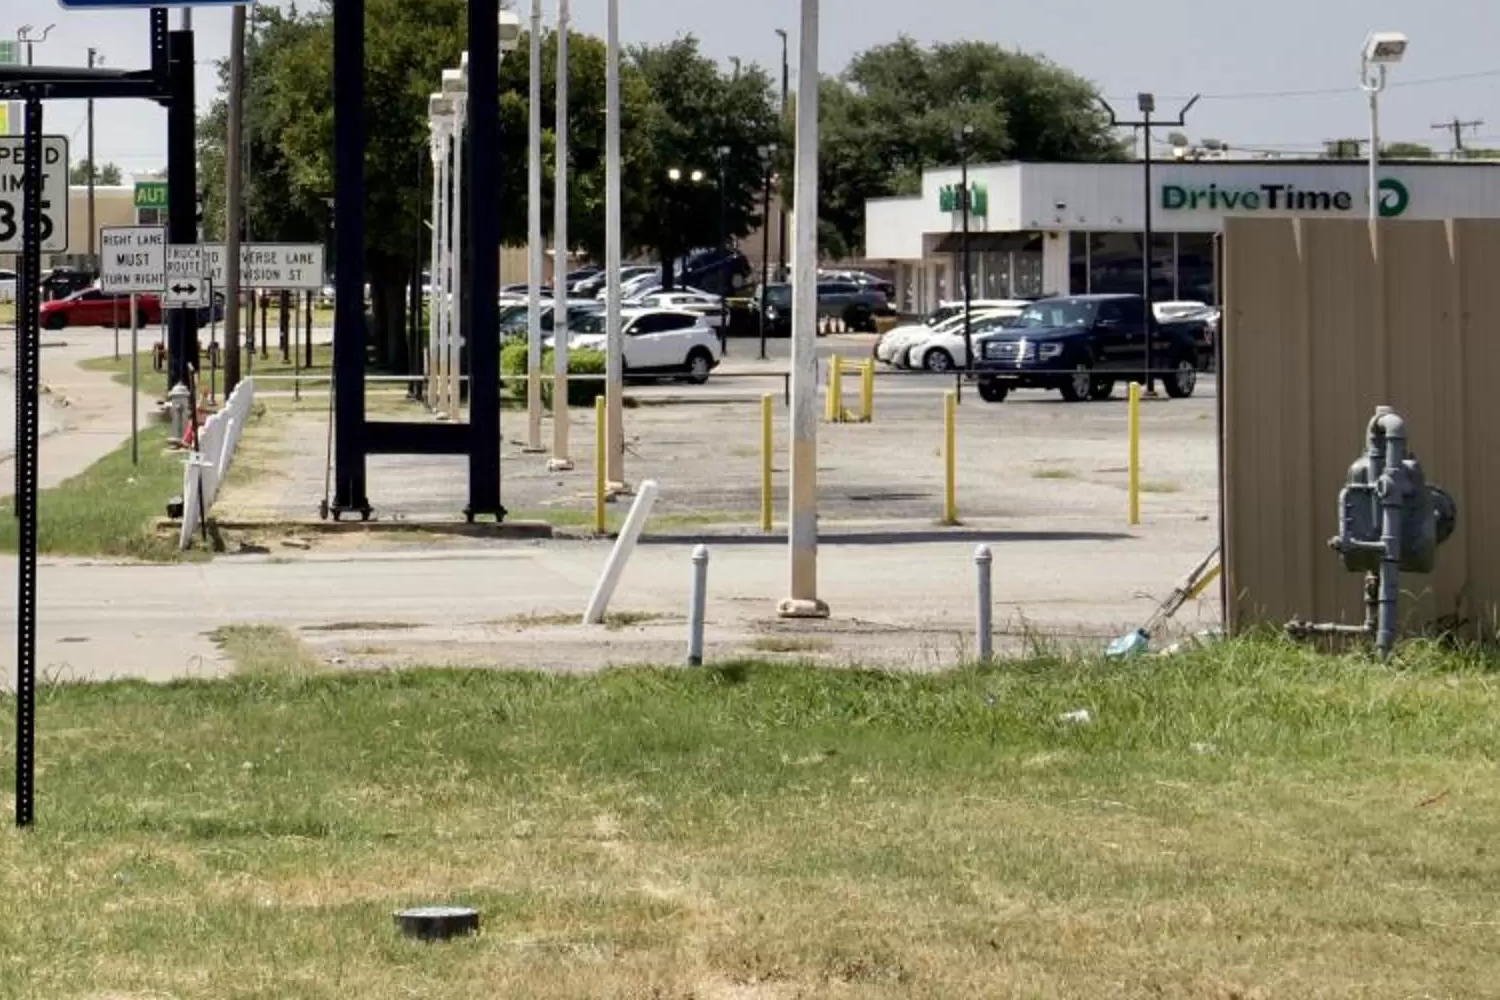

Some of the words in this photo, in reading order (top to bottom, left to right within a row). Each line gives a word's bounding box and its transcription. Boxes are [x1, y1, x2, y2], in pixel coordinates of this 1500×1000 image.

[137, 187, 166, 202] AUT
[1161, 182, 1352, 211] DriveTime
[103, 235, 132, 245] RIGHT
[137, 234, 162, 245] LANE
[167, 247, 200, 258] TRUCK
[241, 252, 277, 264] VERSE
[285, 252, 316, 264] LANE
[116, 253, 149, 267] MUST
[167, 261, 200, 272] ROUTE
[105, 273, 130, 284] TURN
[135, 273, 164, 284] RIGHT
[241, 268, 280, 280] VISION
[287, 269, 302, 281] ST
